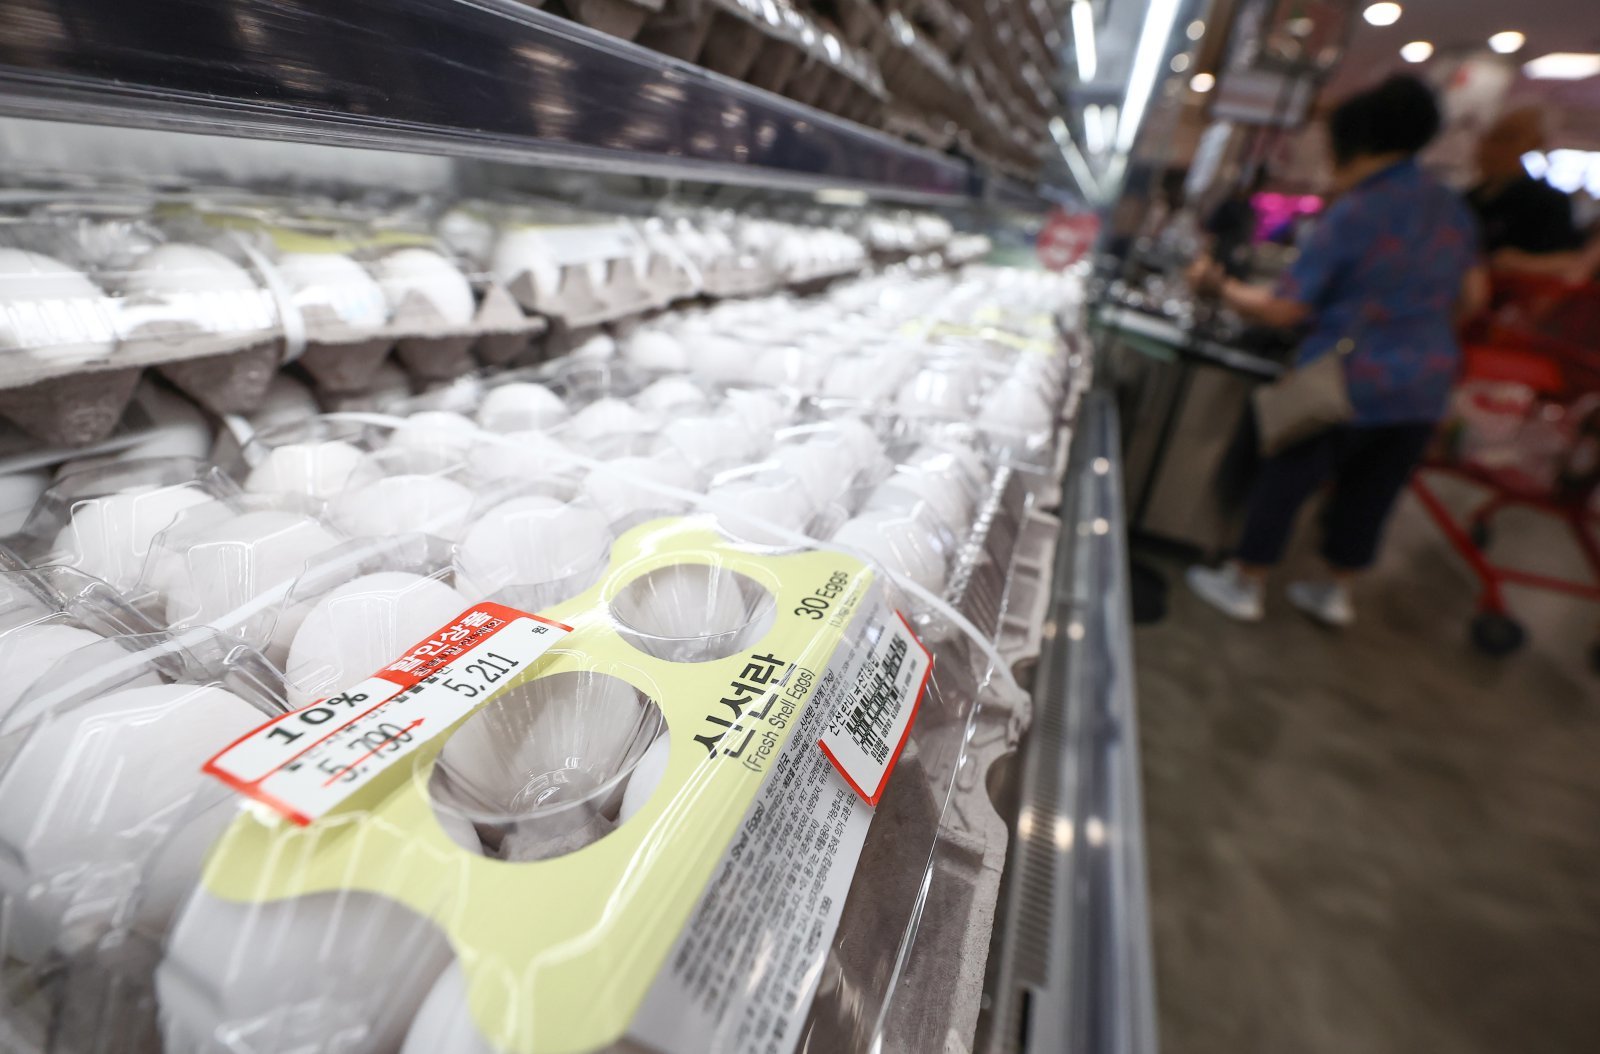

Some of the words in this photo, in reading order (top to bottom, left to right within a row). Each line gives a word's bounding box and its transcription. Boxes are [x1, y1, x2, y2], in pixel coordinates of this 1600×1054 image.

[386, 610, 492, 673] 할인상품
[794, 597, 829, 620] 30
[816, 571, 848, 599] Eggs
[317, 723, 413, 782] 5,790
[442, 652, 519, 698] 5,211
[531, 625, 549, 635] 원
[693, 653, 797, 760] 신선란
[742, 730, 780, 772] (Fresh
[769, 697, 797, 729] Shell
[785, 667, 816, 700] Eggs)
